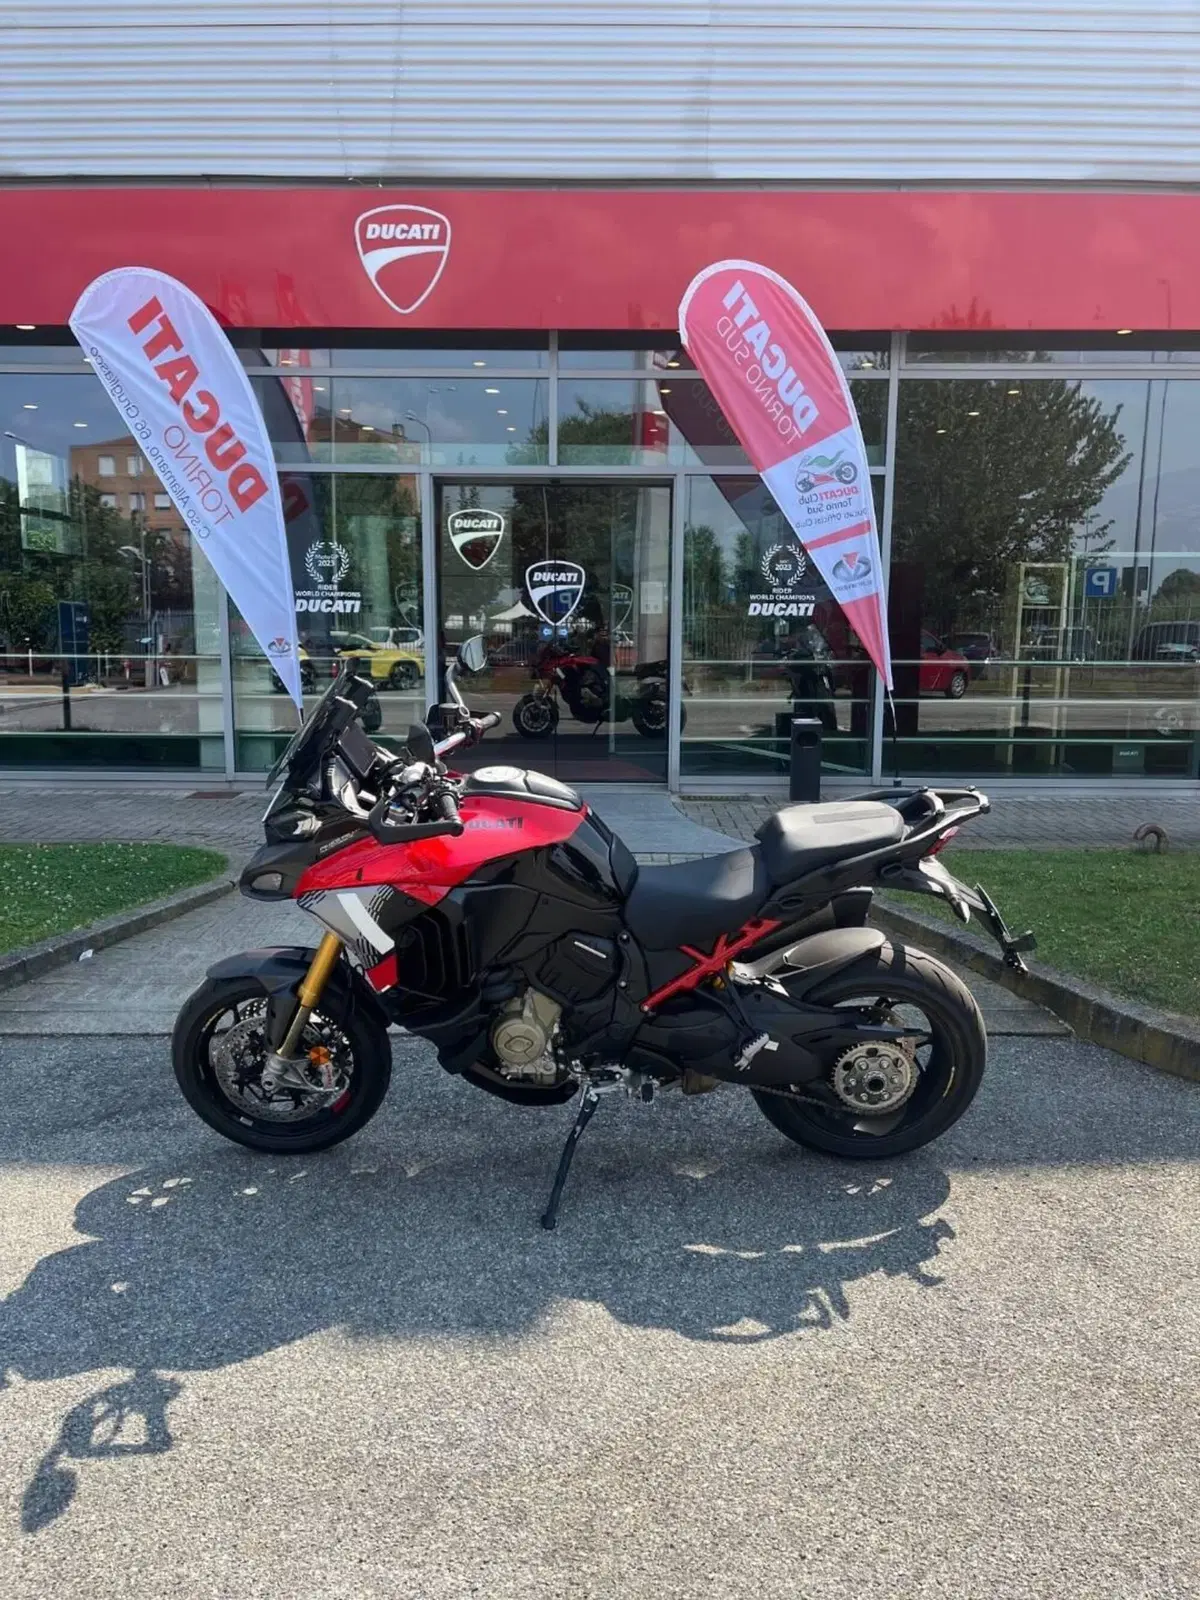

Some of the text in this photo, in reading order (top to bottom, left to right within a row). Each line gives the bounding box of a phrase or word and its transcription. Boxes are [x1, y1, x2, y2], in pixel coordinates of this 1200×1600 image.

[366, 223, 440, 240] DUCATI
[454, 518, 499, 529] DUCATI
[774, 563, 793, 571] 2023
[533, 571, 579, 583] DUCATI
[295, 599, 362, 613] DUCATI
[747, 602, 816, 617] DUCATI
[464, 816, 523, 829] UCATI
